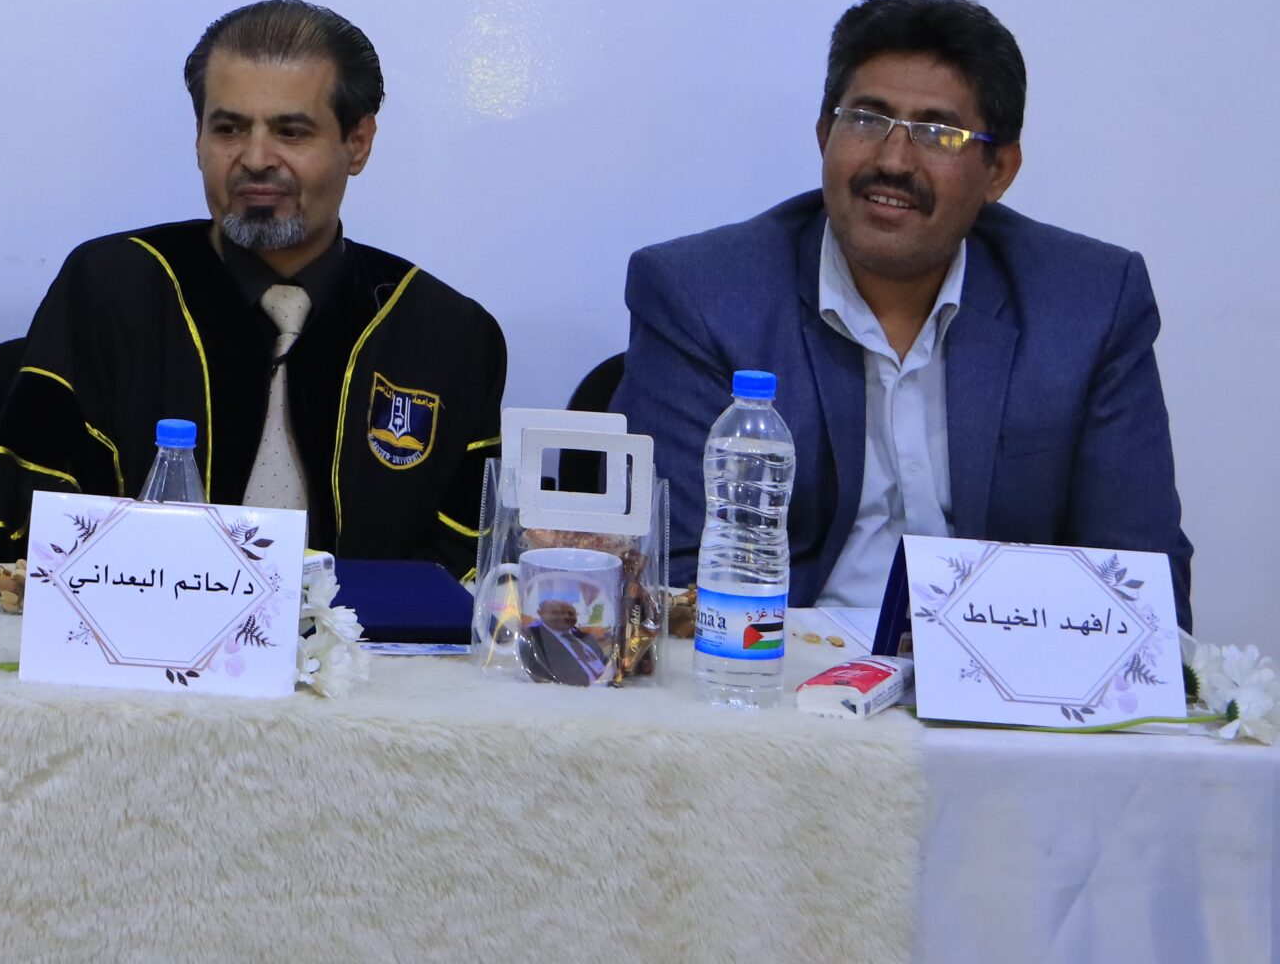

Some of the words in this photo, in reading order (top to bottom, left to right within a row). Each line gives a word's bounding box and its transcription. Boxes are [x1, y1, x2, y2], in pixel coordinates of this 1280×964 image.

[69, 564, 164, 595] البعداني
[174, 569, 255, 600] د/حاتم
[963, 602, 1047, 631] الخياط
[1060, 608, 1128, 636] د/فهد
